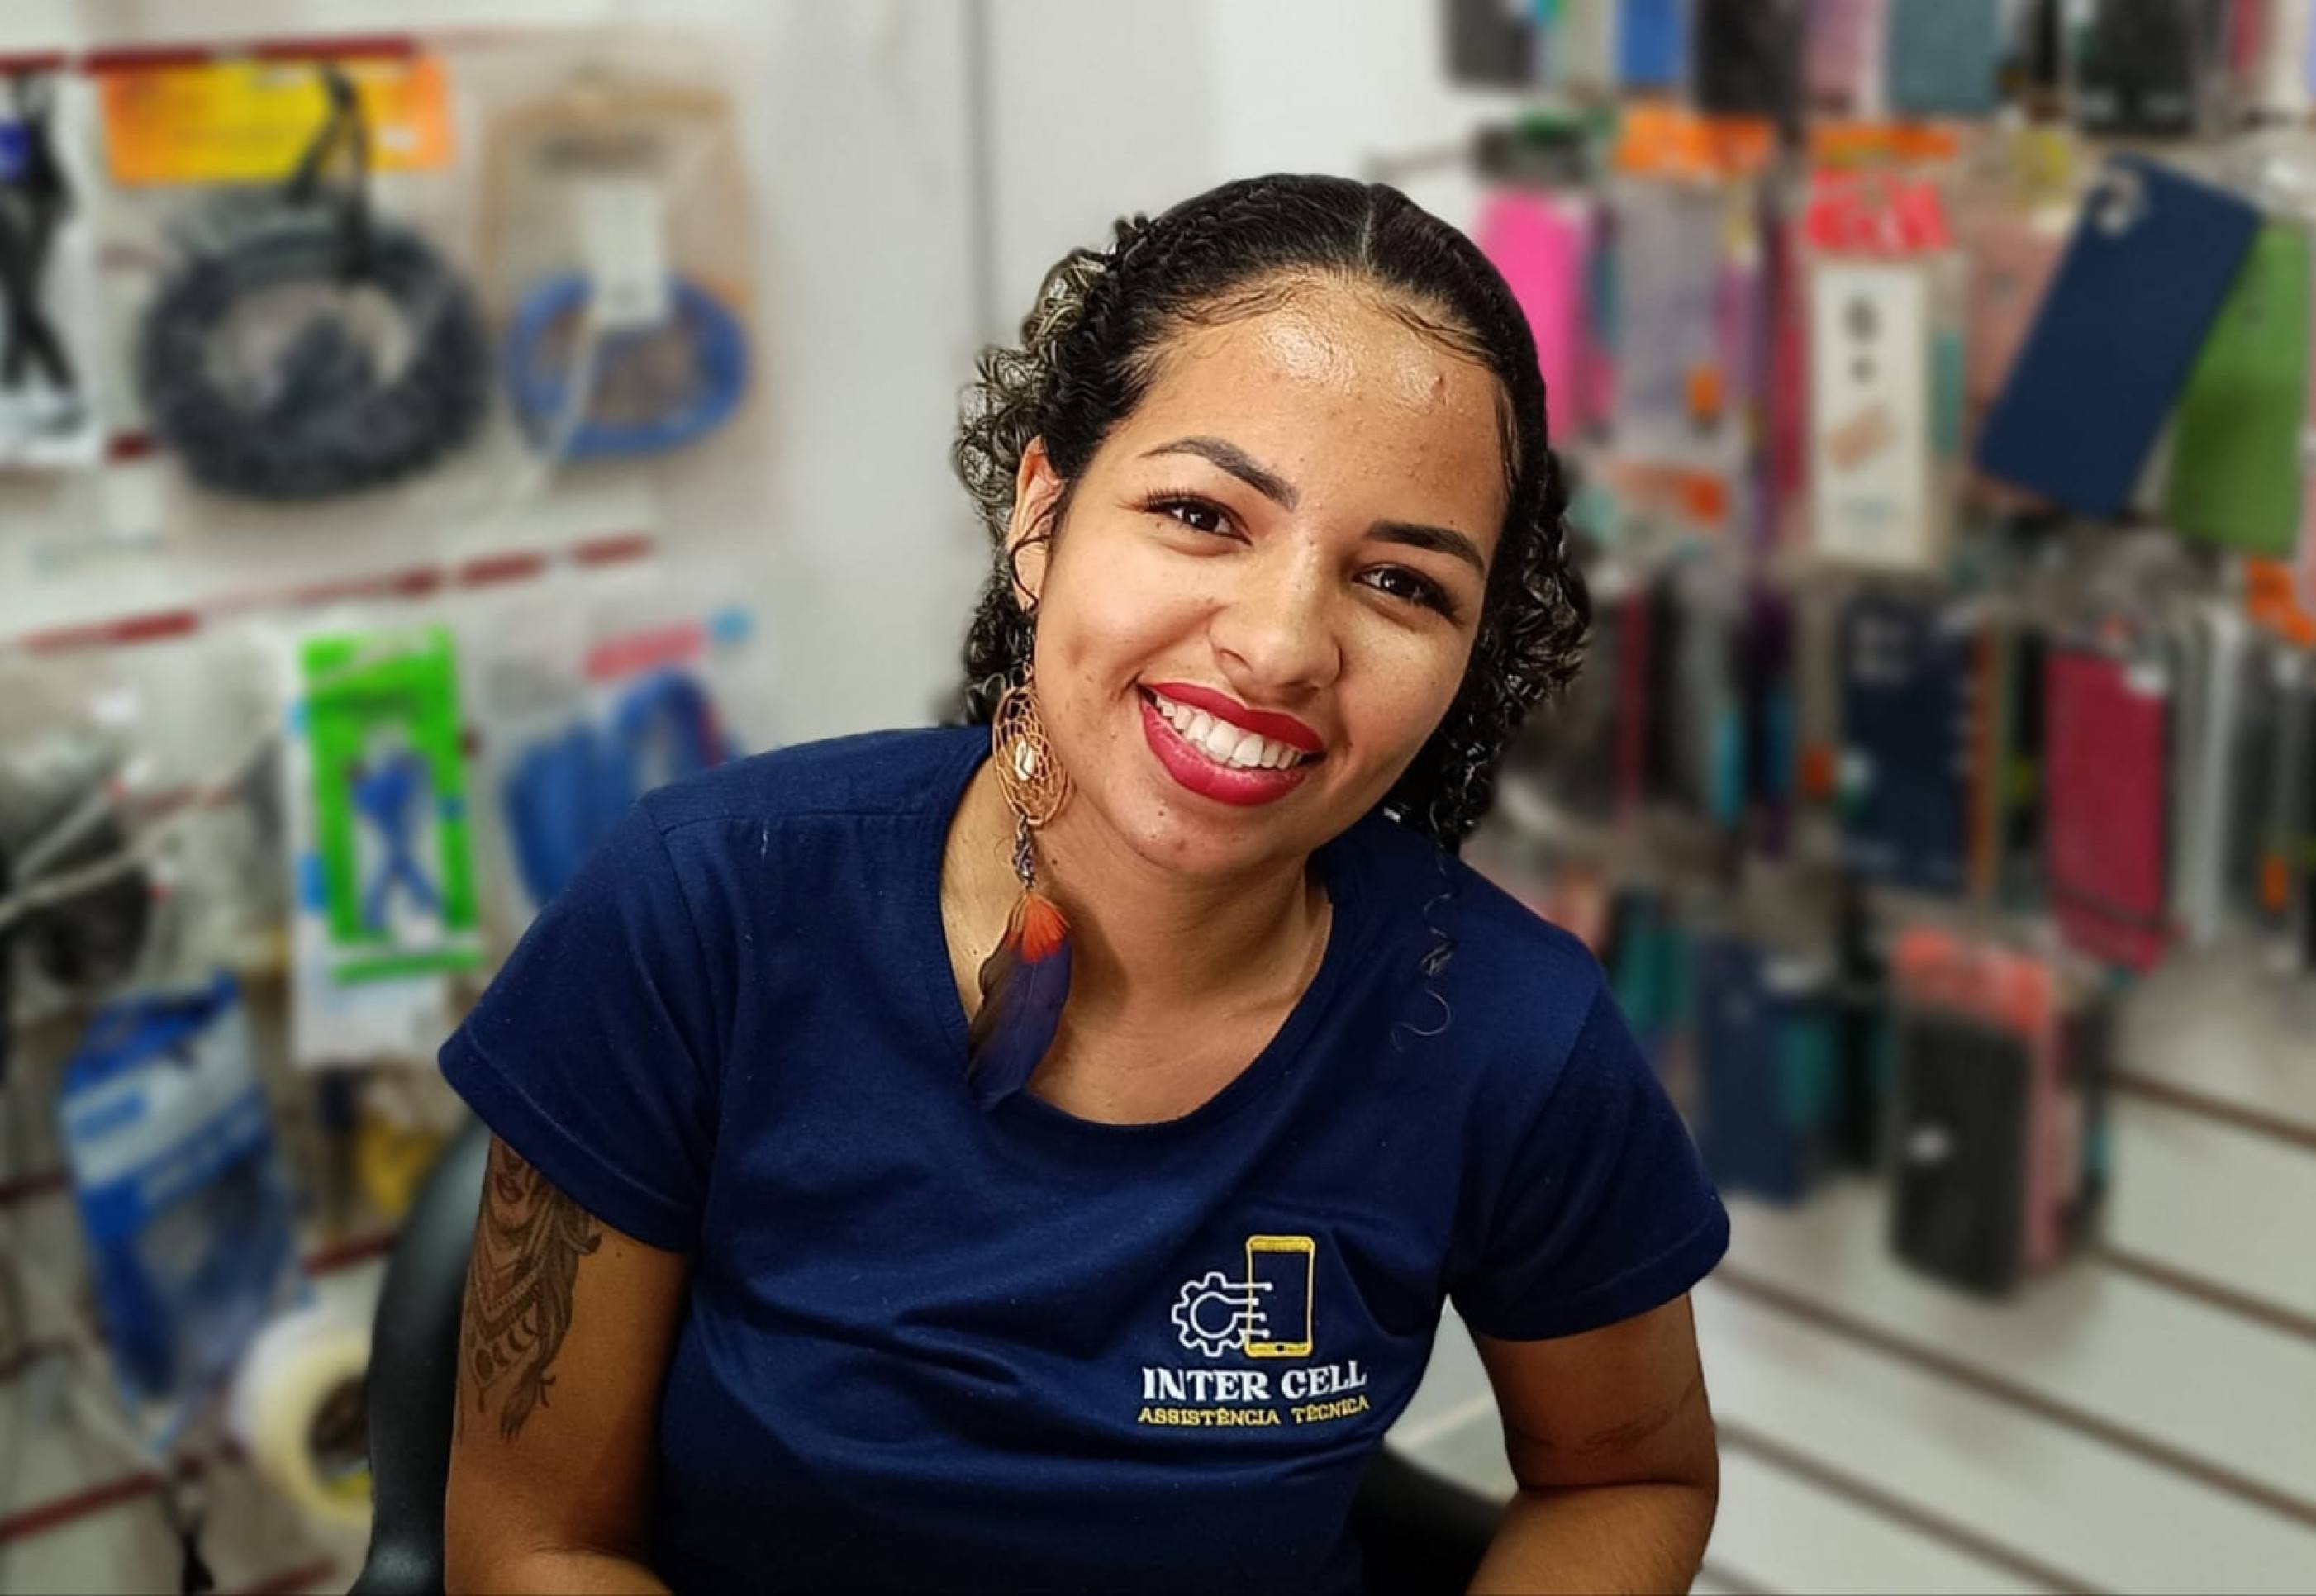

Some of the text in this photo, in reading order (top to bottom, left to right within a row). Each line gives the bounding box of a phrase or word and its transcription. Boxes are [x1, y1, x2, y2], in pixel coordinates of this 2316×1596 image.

[1143, 1361, 1367, 1401] INTER CELL
[1138, 1407, 1280, 1425] ASSISTÊNCIA
